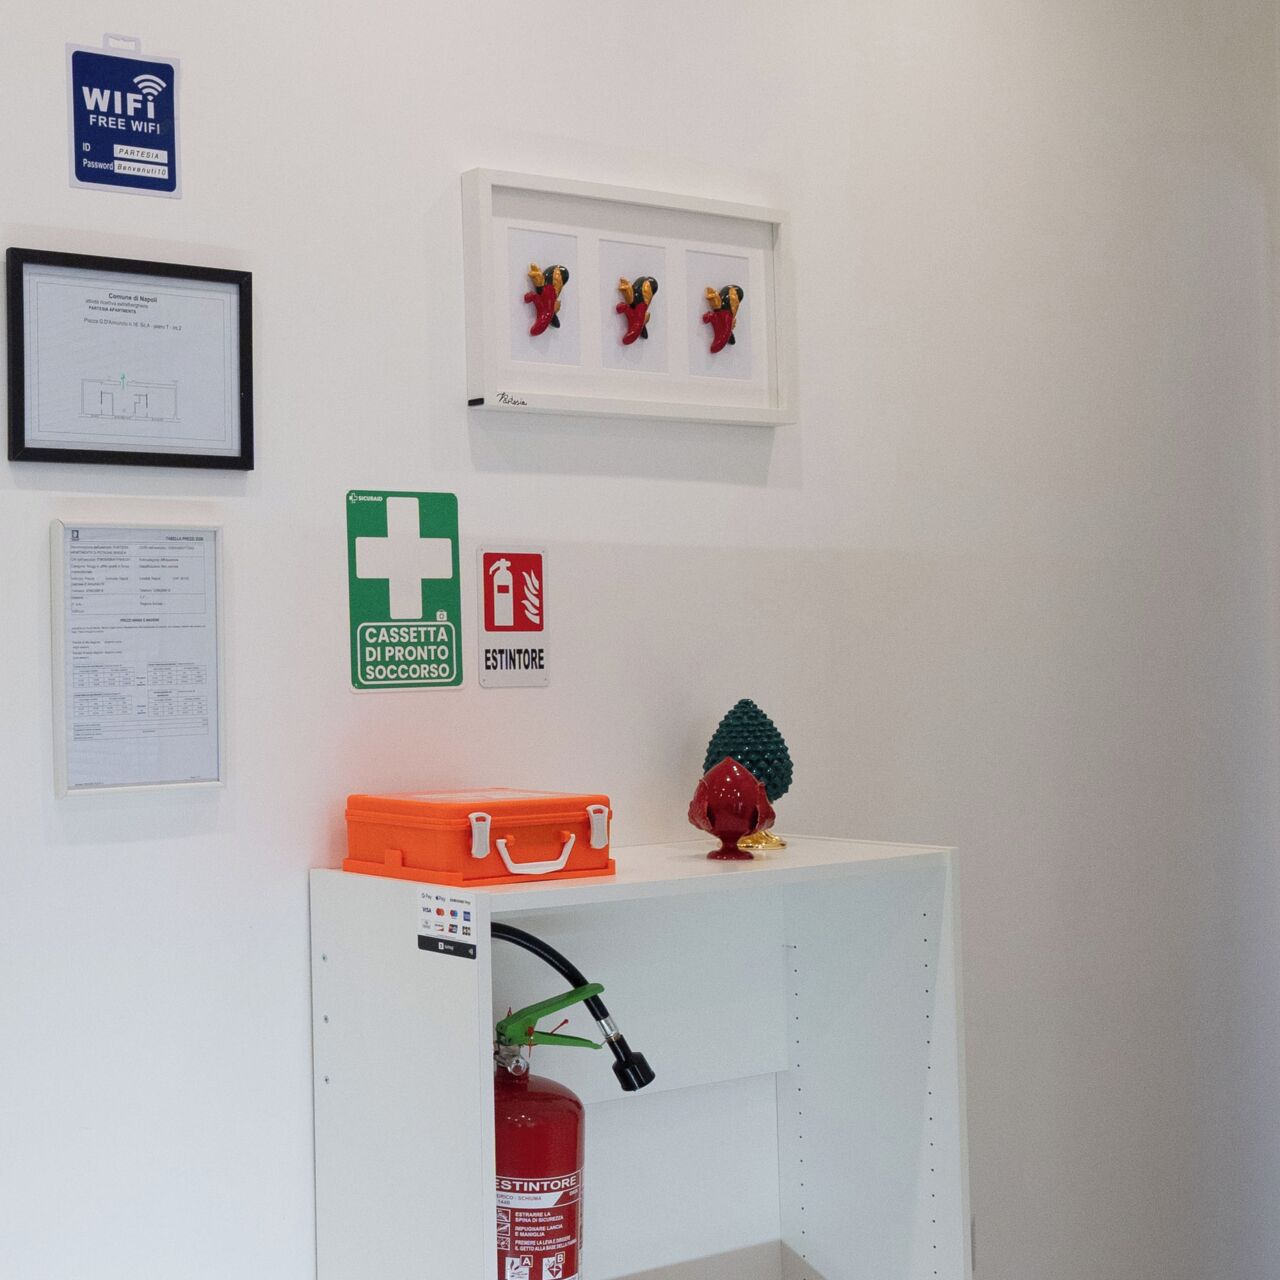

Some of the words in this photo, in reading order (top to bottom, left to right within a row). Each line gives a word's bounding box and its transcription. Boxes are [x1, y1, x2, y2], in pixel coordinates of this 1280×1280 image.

[90, 115, 126, 130] FREE
[131, 120, 160, 134] WIFI
[82, 143, 91, 152] ID
[119, 149, 159, 160] PARTESIA
[83, 159, 114, 170] Password
[365, 626, 448, 643] CASSETTA
[366, 647, 381, 662] DI
[385, 646, 449, 661] PRONTO
[485, 648, 544, 670] ESTINTORE
[366, 664, 449, 679] SOCCORSO
[523, 1258, 531, 1266] A
[558, 1255, 563, 1263] B
